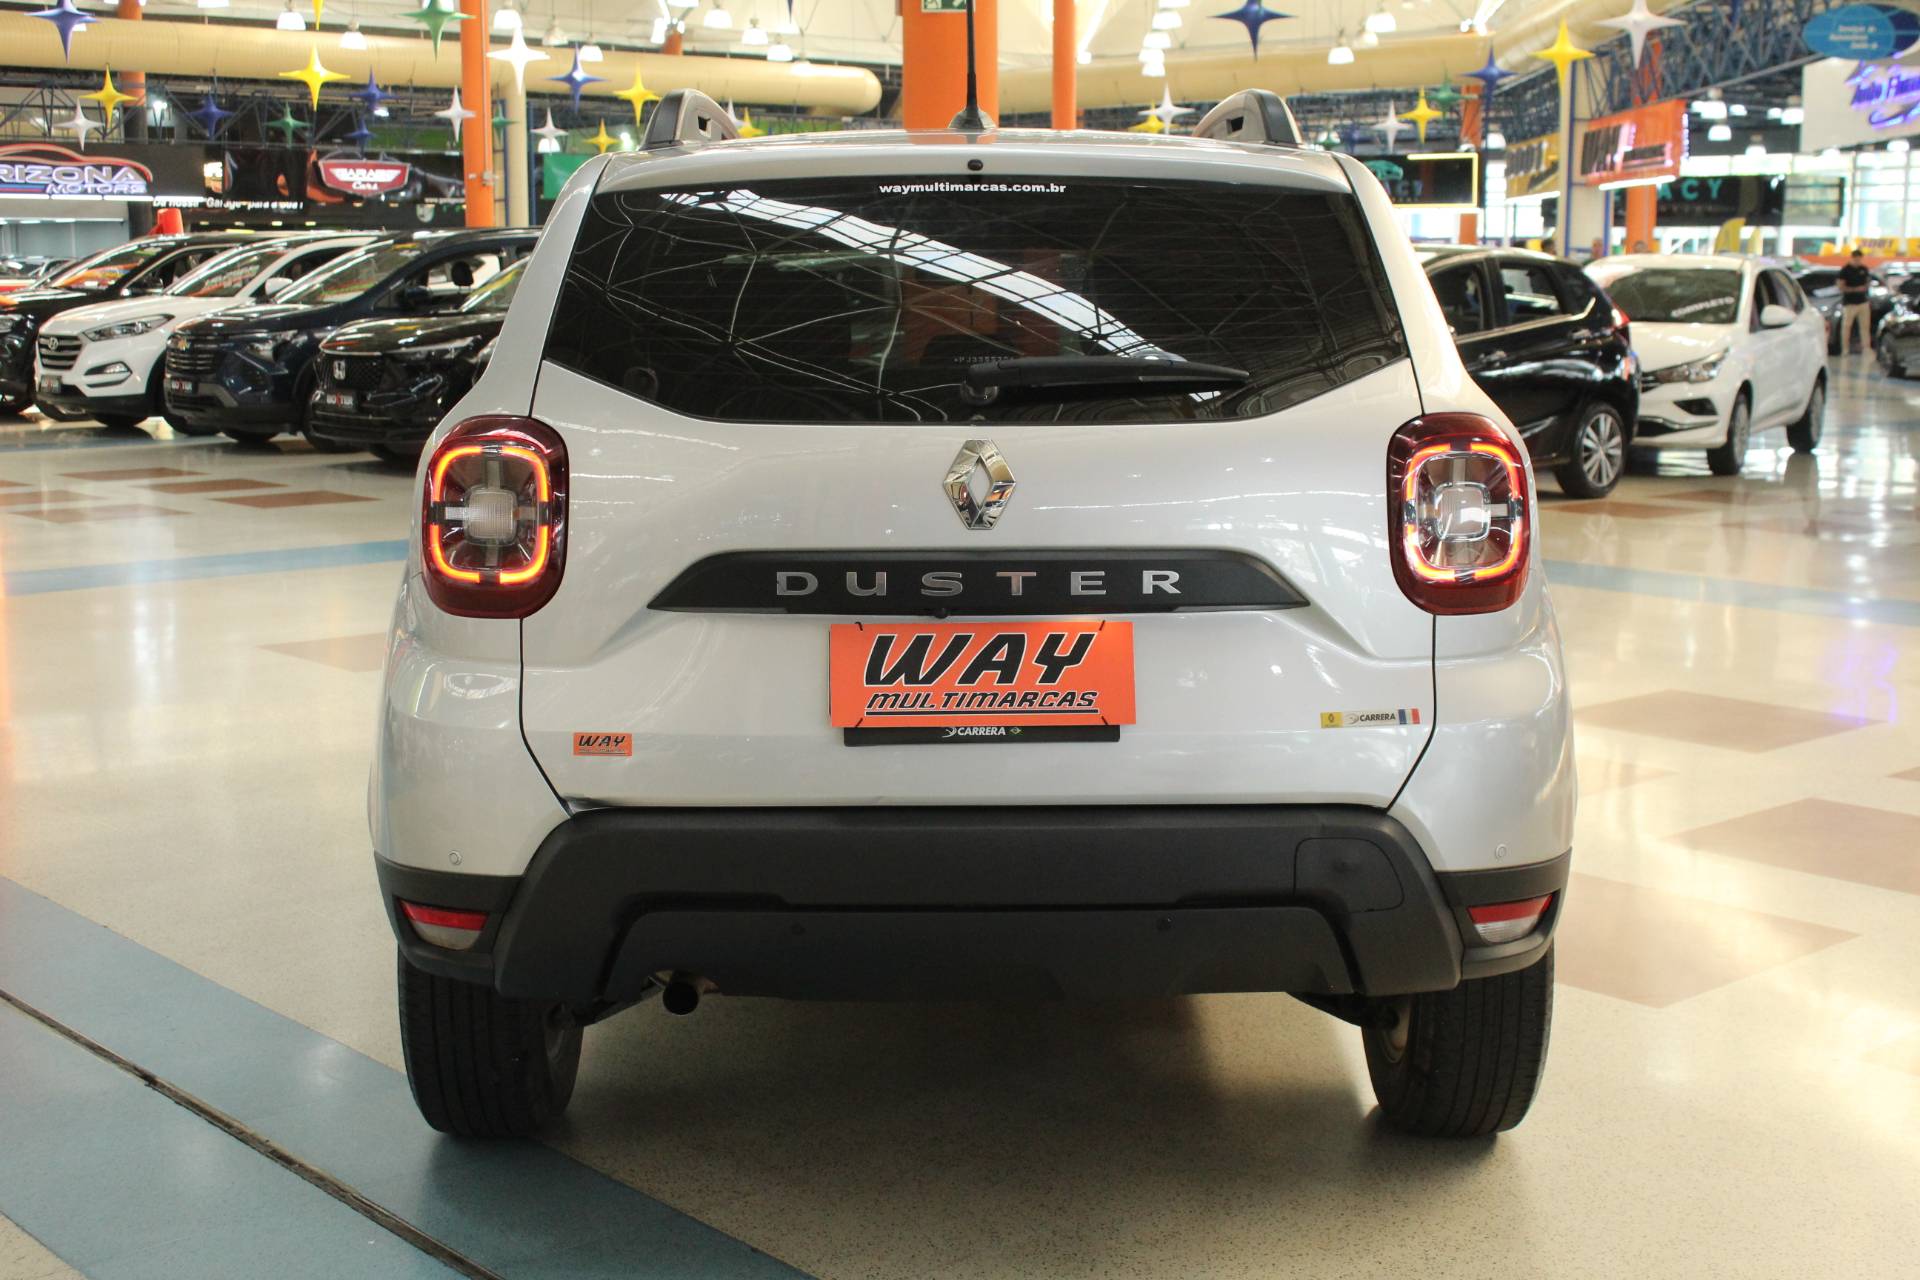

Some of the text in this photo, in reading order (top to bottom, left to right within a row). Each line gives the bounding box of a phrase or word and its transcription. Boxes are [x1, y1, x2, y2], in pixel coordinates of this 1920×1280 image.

[46, 183, 147, 195] MOTORS
[879, 182, 1066, 195] waymultimarcas.com.br
[776, 570, 1182, 597] DUSTER
[864, 632, 1098, 687] WAY
[865, 690, 1099, 711] MULTIMARCAS
[1359, 712, 1397, 723] CARRERA
[957, 726, 1007, 736] CARRERA
[578, 735, 626, 748] WAY
